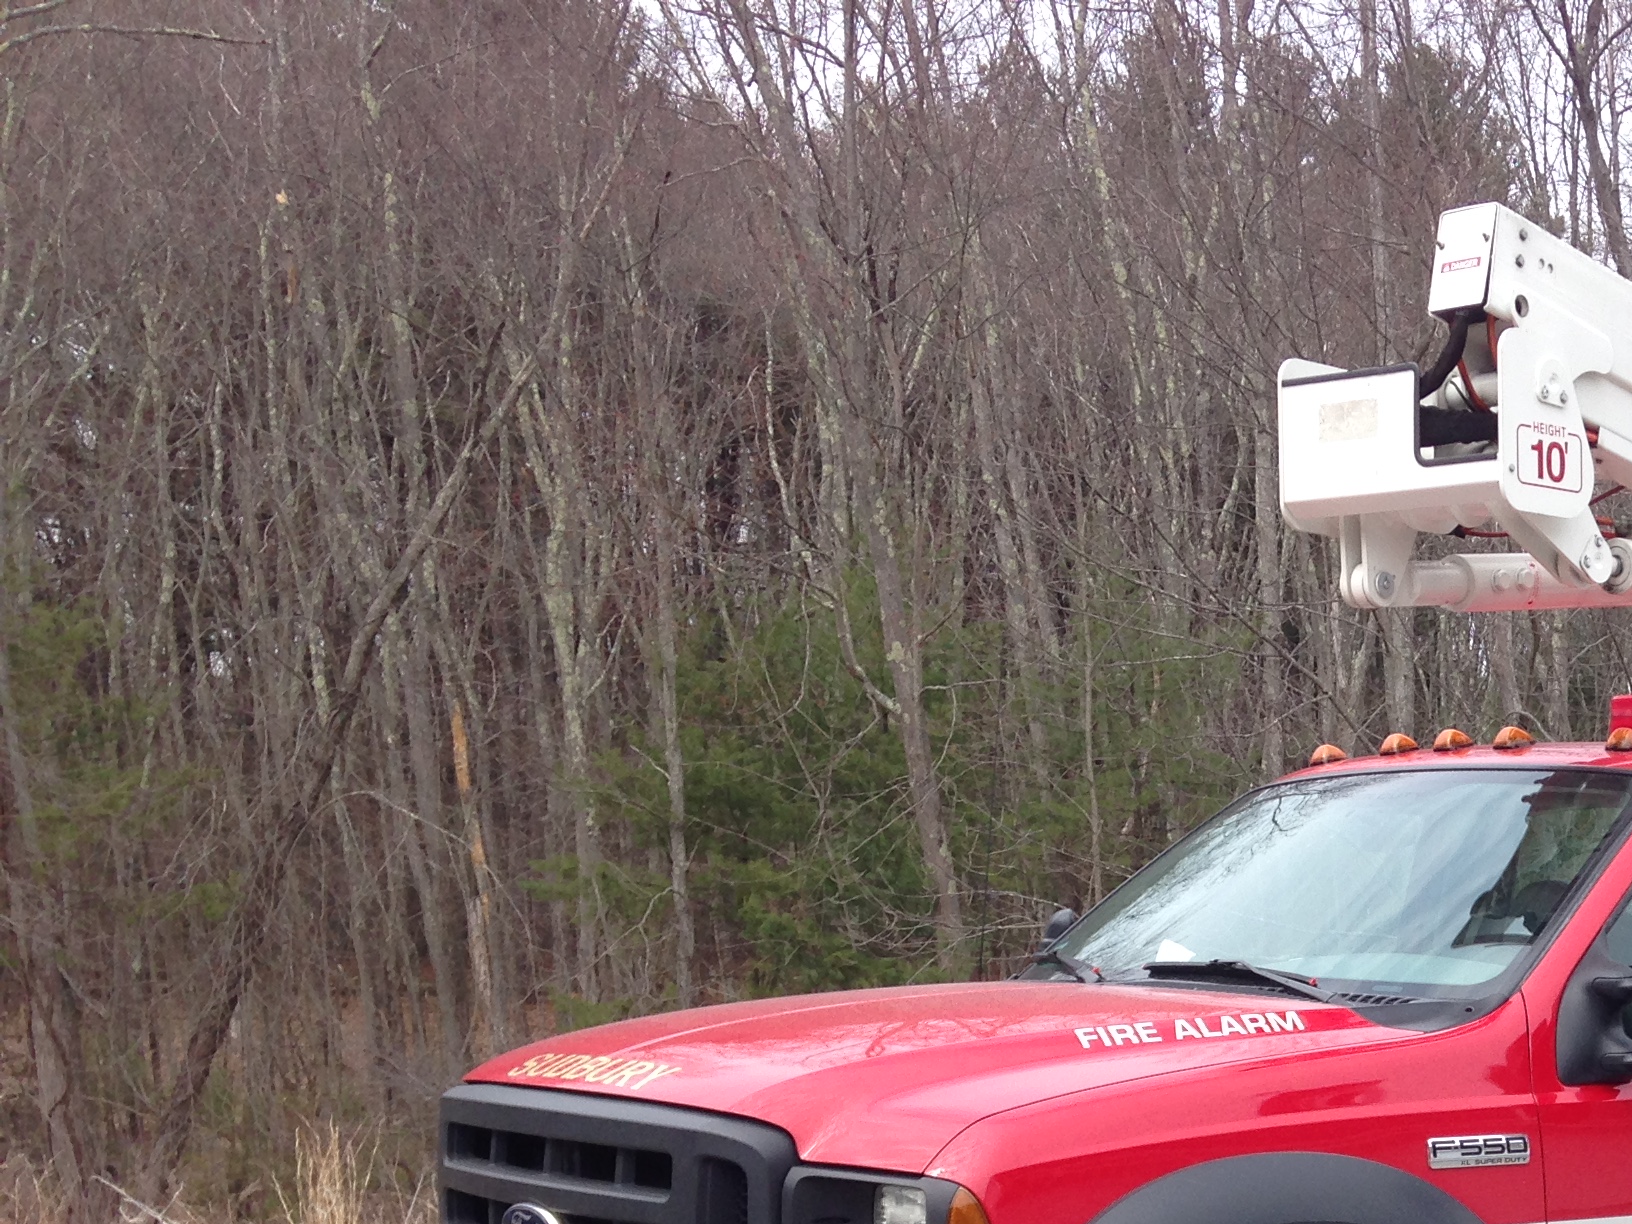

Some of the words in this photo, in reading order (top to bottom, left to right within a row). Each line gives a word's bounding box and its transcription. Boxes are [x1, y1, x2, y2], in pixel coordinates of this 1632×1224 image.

[1533, 421, 1566, 438] HEIGHT
[1531, 439, 1568, 483] 10'
[1074, 1021, 1162, 1049] FIRE
[1174, 1010, 1305, 1040] ALARM
[507, 1053, 682, 1090] SUDBURY
[1431, 1137, 1527, 1158] F-550
